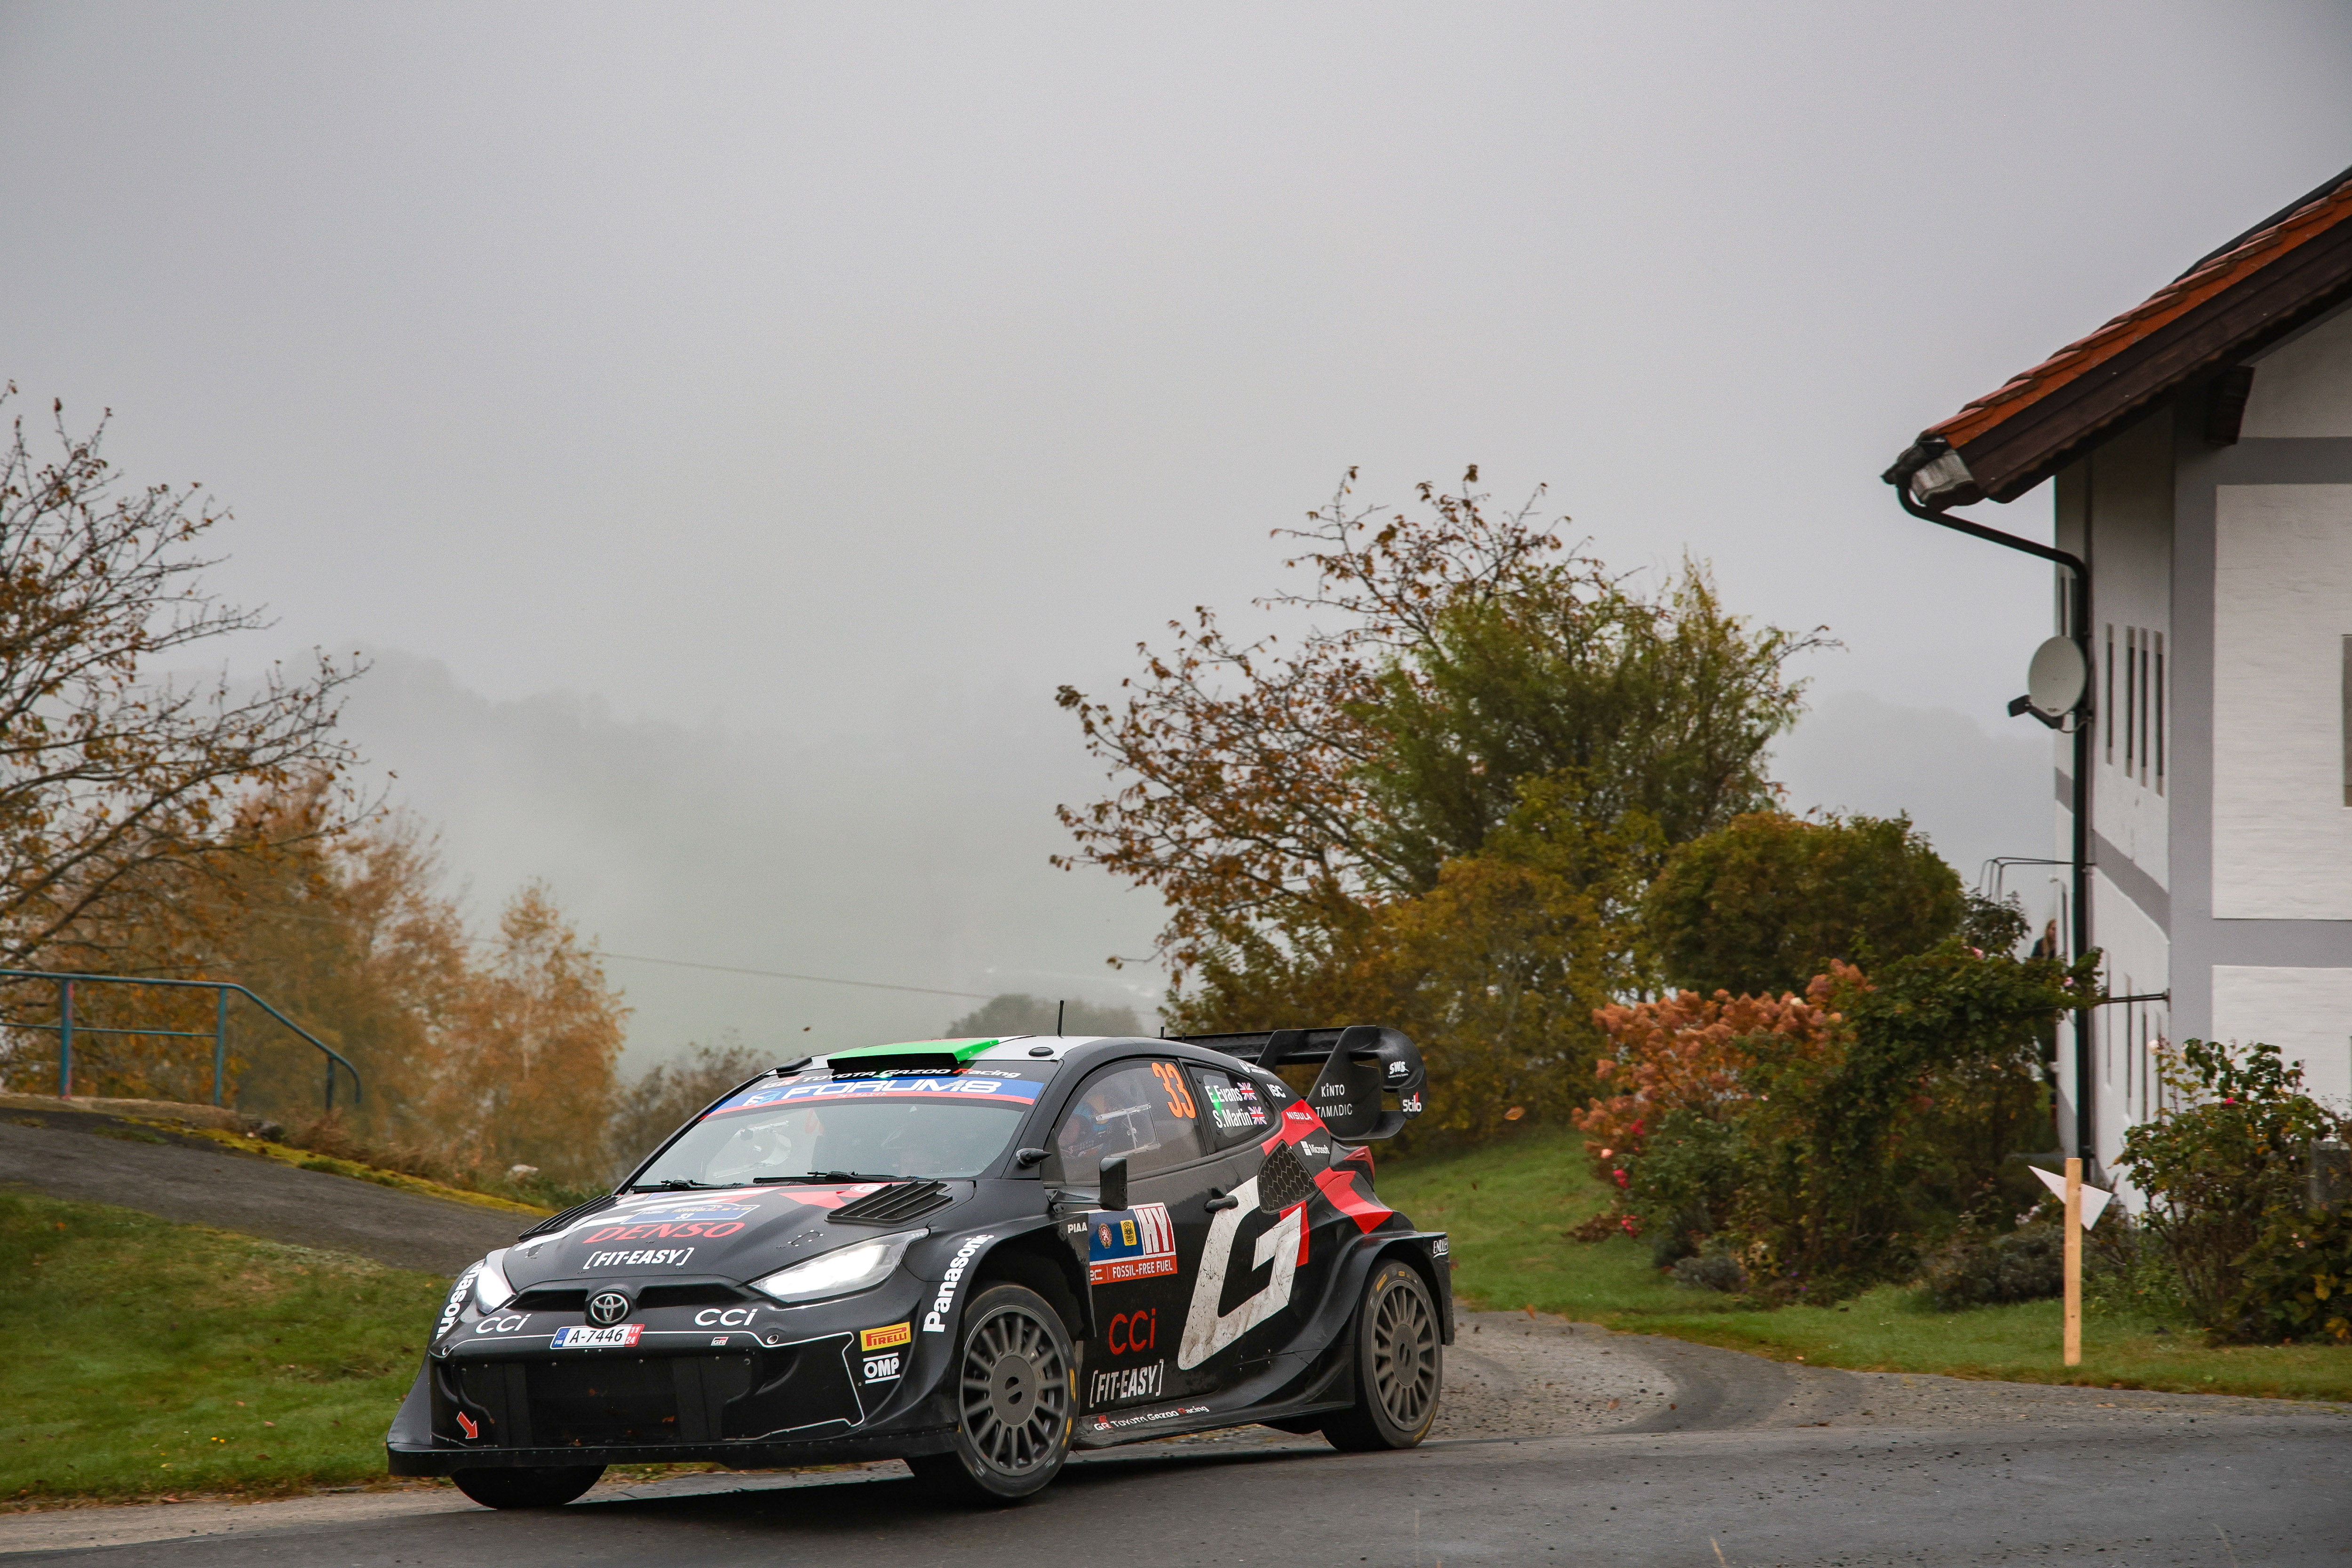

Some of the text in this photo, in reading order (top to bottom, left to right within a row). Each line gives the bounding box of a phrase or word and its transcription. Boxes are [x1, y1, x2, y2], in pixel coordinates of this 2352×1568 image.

[803, 1071, 876, 1082] TOYOTA
[953, 1068, 1022, 1078] Racing
[1389, 1061, 1407, 1074] SWS
[781, 1079, 1002, 1100] FORUM8
[1151, 1062, 1196, 1119] 33
[1204, 1085, 1243, 1103] E.Evans
[1315, 1103, 1352, 1118] TAMADIC
[1402, 1095, 1422, 1112] Stilo
[1212, 1108, 1253, 1128] S.Martin
[1286, 1111, 1313, 1120] NISULA
[581, 1222, 746, 1244] DENSO
[1067, 1222, 1088, 1234] PIAA
[1112, 1261, 1155, 1279] FOSSIL-FREE
[1156, 1259, 1173, 1273] FUEL
[922, 1234, 994, 1332] Panasonic
[569, 1329, 625, 1344] A-7446
[866, 1326, 907, 1347] PIRELLI
[864, 1357, 899, 1378] OMP
[1110, 1416, 1149, 1427] TOYOTA
[1147, 1410, 1179, 1421] GAZOO
[1177, 1405, 1210, 1415] Racing
